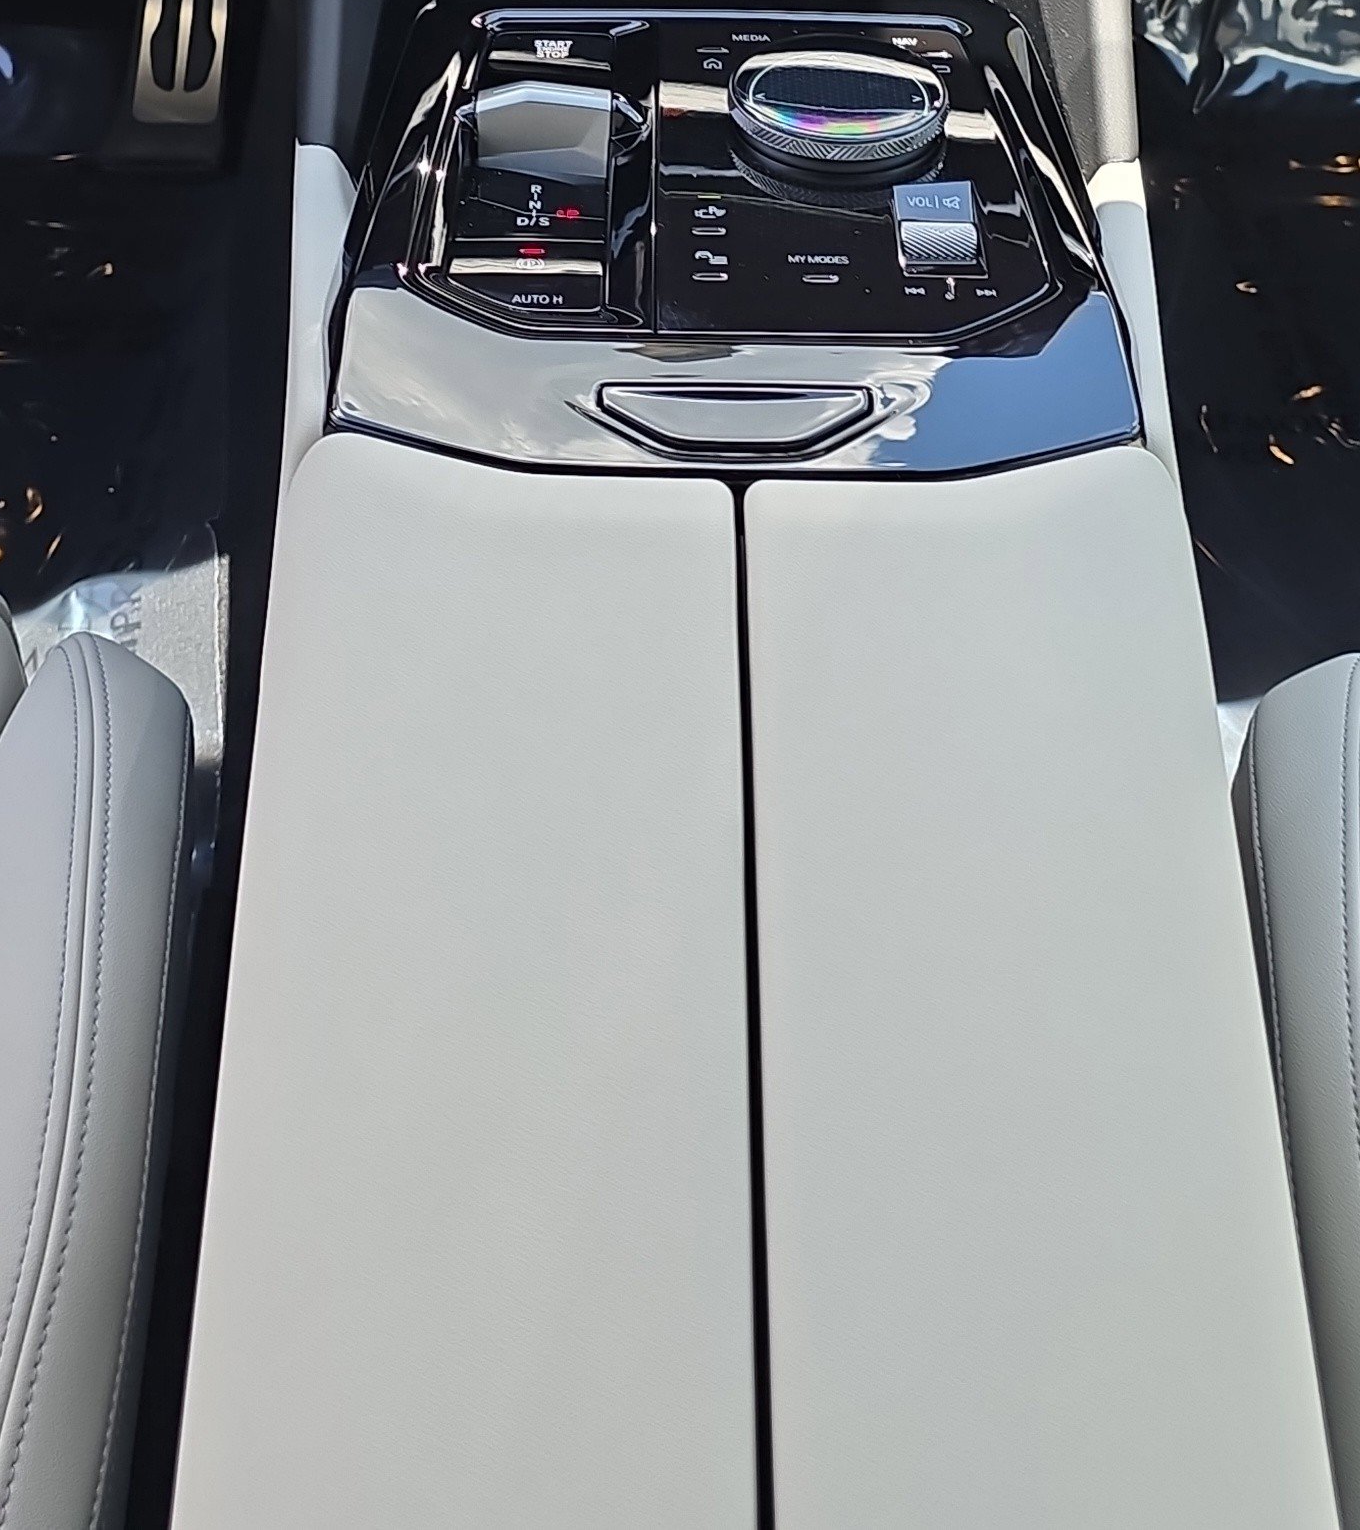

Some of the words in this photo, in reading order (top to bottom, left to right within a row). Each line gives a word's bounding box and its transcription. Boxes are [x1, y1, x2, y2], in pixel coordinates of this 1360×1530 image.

[731, 33, 772, 43] MEDIA
[892, 37, 919, 47] NAV
[534, 39, 573, 48] START
[536, 50, 570, 59] STOP
[530, 184, 542, 194] R
[528, 200, 542, 210] N
[906, 195, 932, 208] VOL
[516, 216, 550, 226] D/S
[787, 254, 807, 265] MY
[808, 254, 850, 265] MODES
[511, 294, 550, 304] AUTO
[552, 294, 564, 305] H
